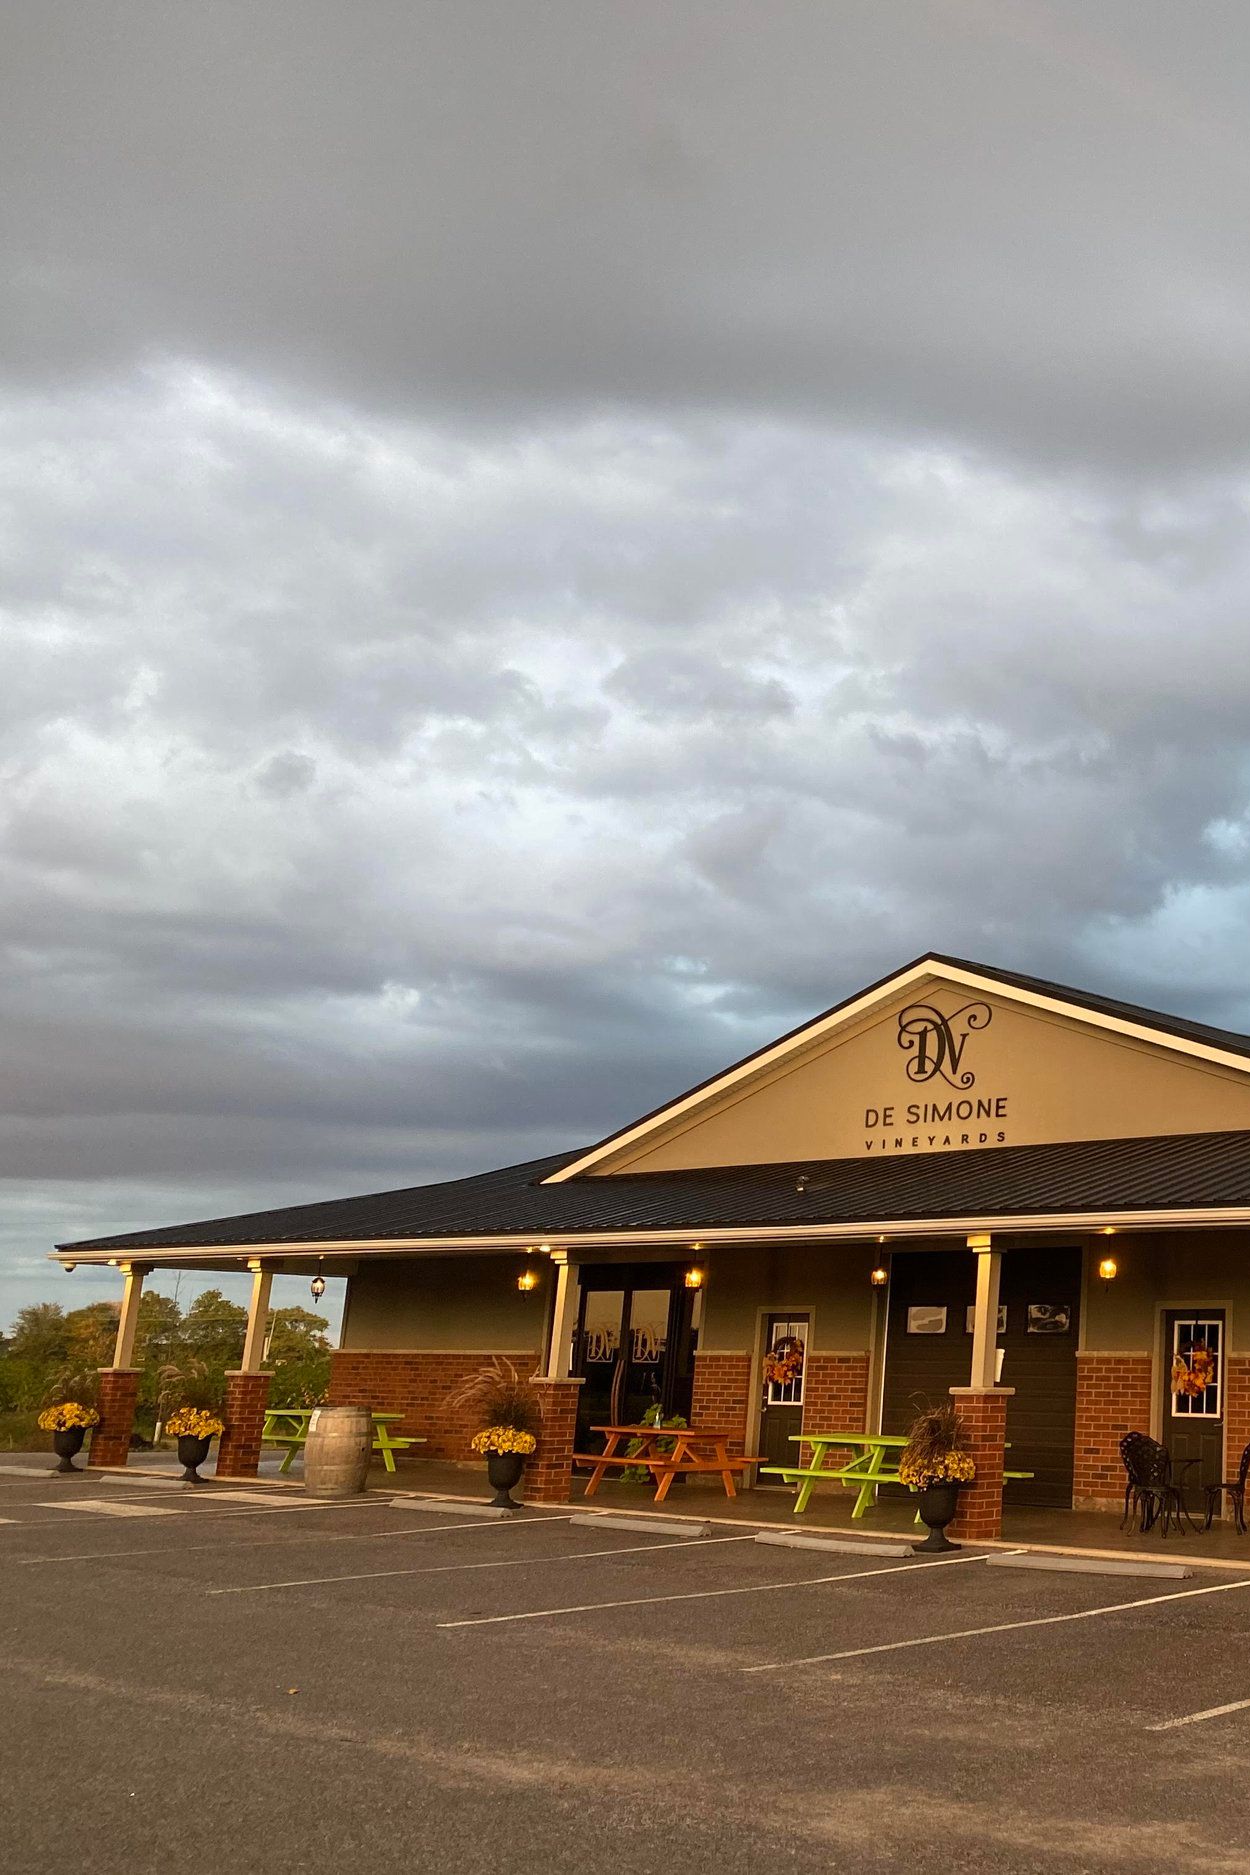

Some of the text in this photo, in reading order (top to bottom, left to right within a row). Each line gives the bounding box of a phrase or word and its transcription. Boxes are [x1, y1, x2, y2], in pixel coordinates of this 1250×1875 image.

[865, 1097, 1008, 1129] DE SIMONE
[865, 1131, 1006, 1151] VINEYARDS
